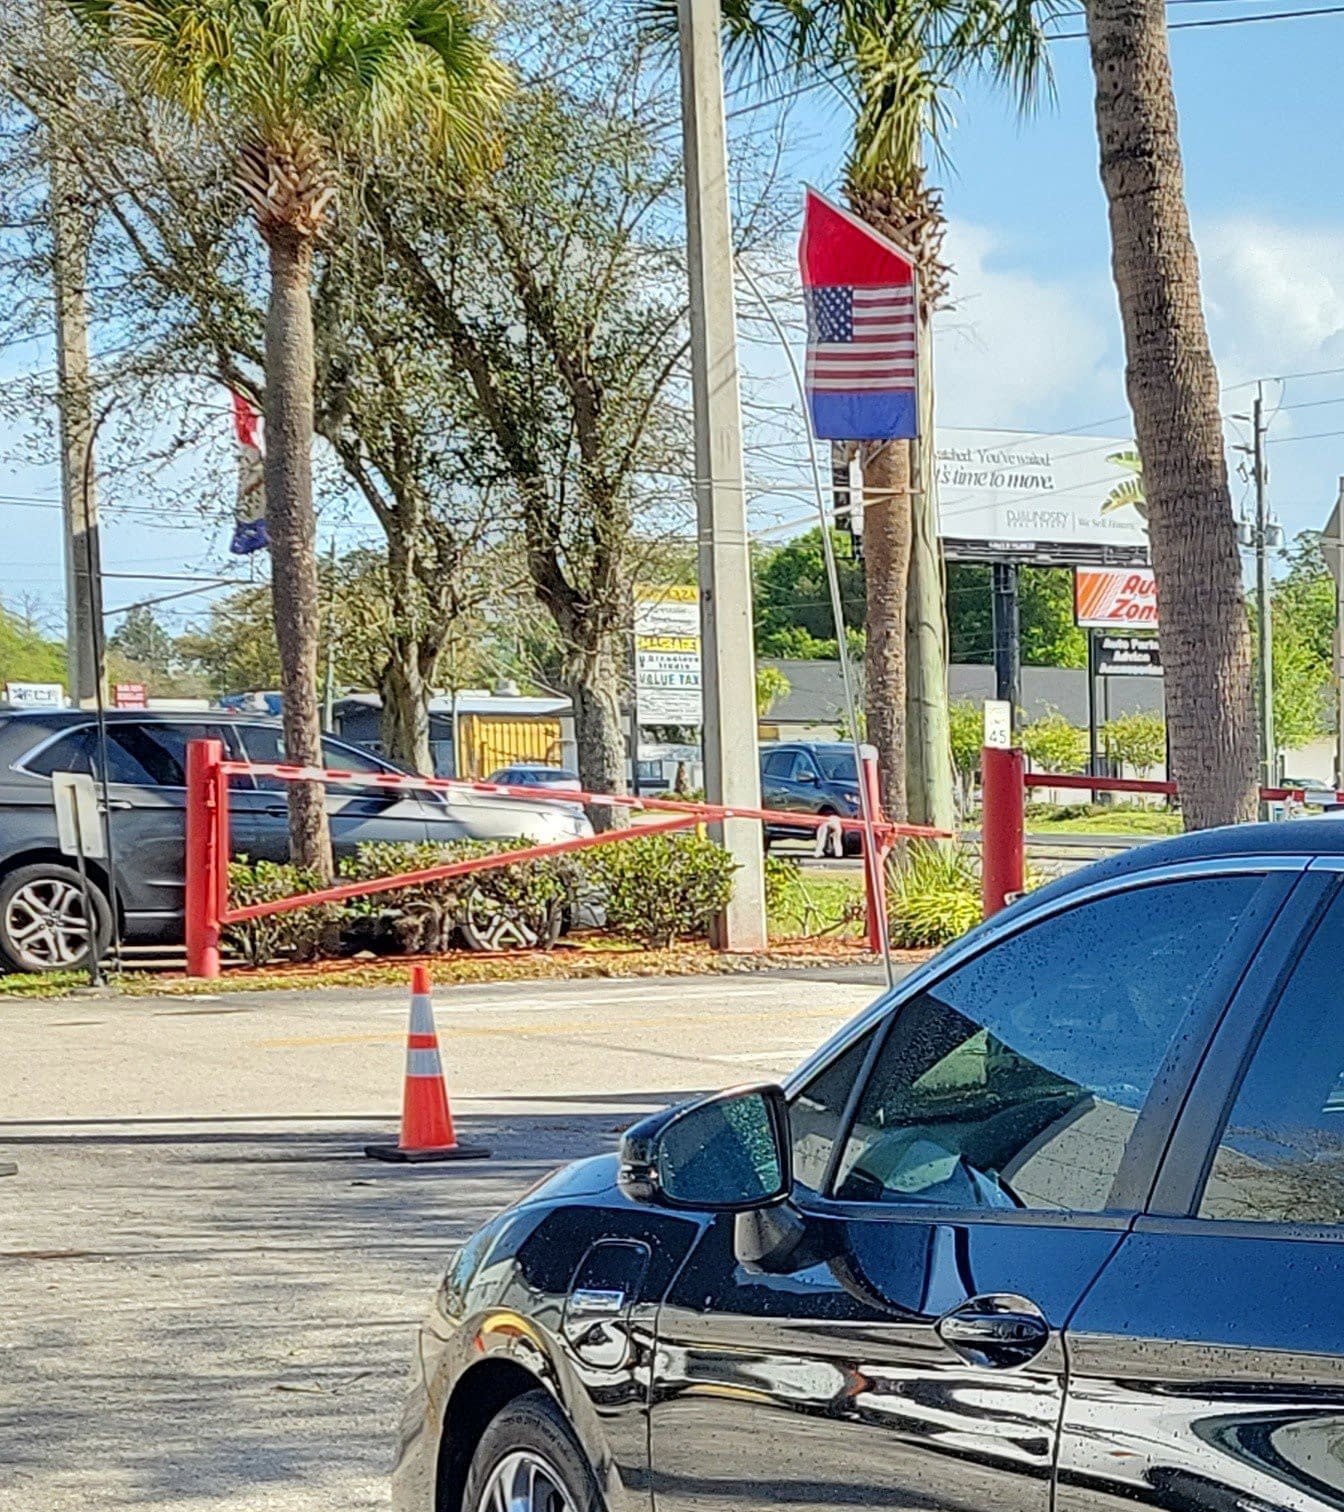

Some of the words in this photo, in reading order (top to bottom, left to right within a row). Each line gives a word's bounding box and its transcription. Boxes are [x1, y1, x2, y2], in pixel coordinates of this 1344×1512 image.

[953, 465, 988, 486] time
[989, 470, 1005, 487] to
[1007, 474, 1054, 489] move.
[639, 673, 678, 686] VALUE
[679, 673, 699, 686] TAX
[989, 729, 1007, 744] 45
